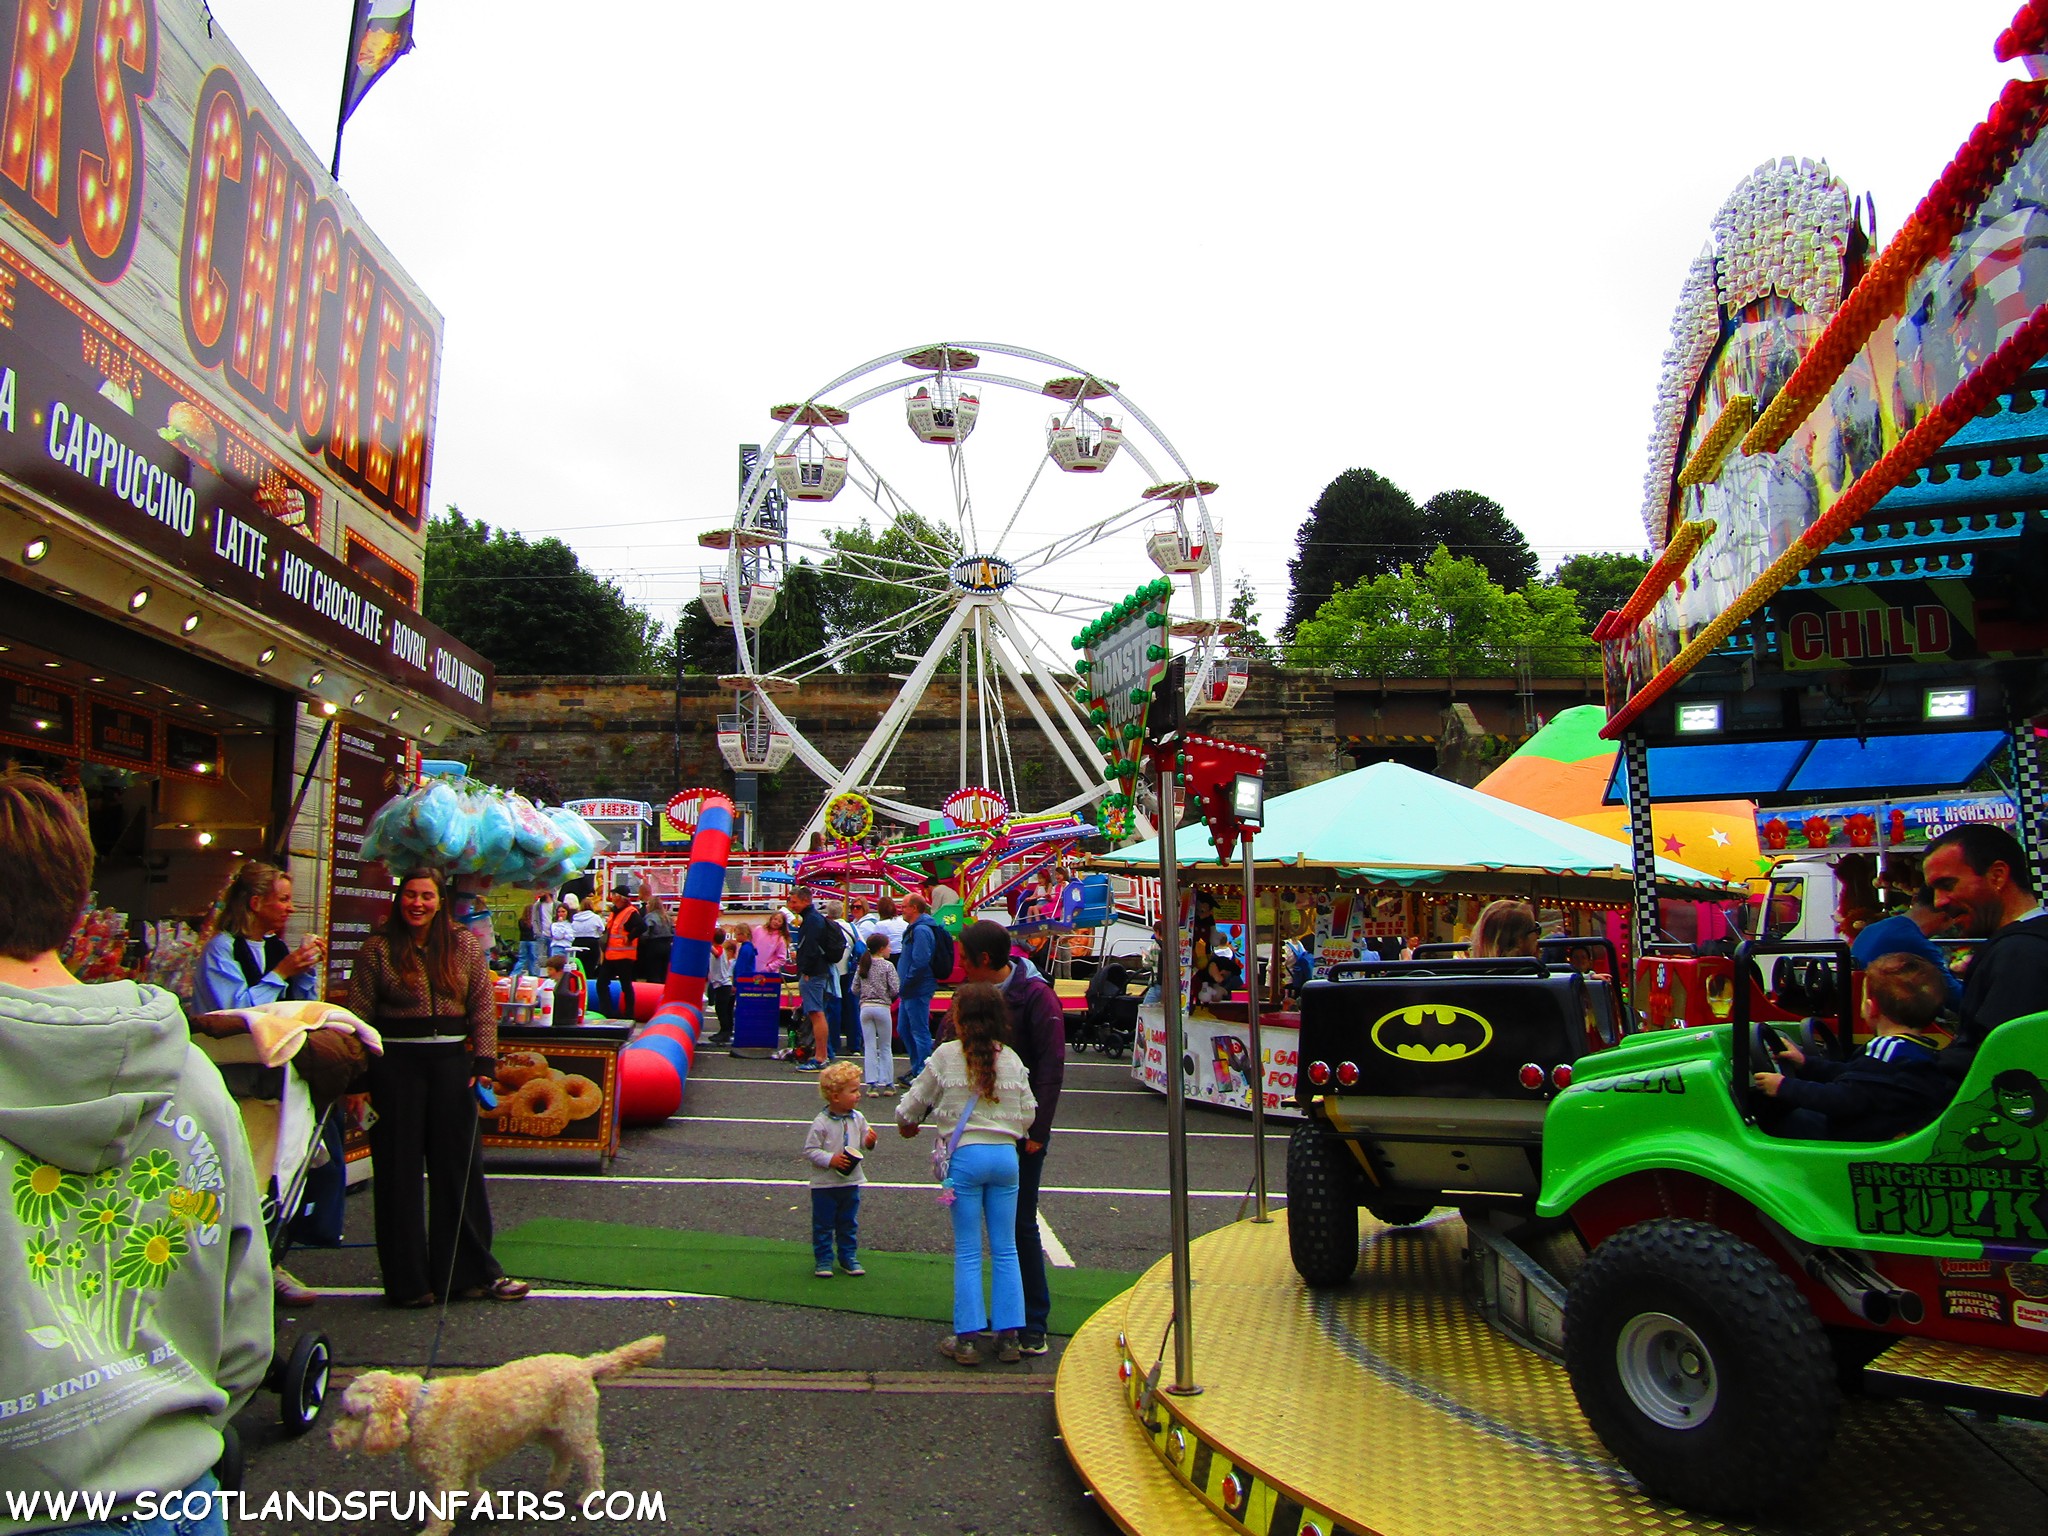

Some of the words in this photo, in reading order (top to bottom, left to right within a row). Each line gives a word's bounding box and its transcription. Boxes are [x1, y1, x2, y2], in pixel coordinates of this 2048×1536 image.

[188, 90, 431, 518] CHICKEN
[82, 327, 143, 399] WRAPS
[225, 437, 257, 481] FOOT
[49, 402, 196, 538] CAPPUCCINO
[215, 508, 268, 580] LATTE
[282, 550, 314, 604] HOT
[313, 569, 384, 646] CHOCOLATE
[392, 619, 427, 672] BOVRIL
[435, 647, 458, 688] COLD
[459, 665, 485, 704] WATER
[954, 563, 985, 585] MOVIE
[988, 563, 1013, 585] STAR
[1789, 604, 1952, 662] CHILD
[1091, 627, 1164, 699] MONSTER
[568, 802, 597, 817] PAY
[601, 802, 638, 817] HERE
[947, 796, 976, 823] MOVIE
[980, 796, 1005, 823] STAR
[1915, 807, 1939, 823] THE
[1322, 949, 1352, 959] OVER
[1151, 1029, 1167, 1045] GAM
[1148, 1047, 1162, 1066] FOR
[1274, 1049, 1298, 1066] GA
[498, 1115, 563, 1134] DONUTS
[1862, 1163, 2040, 1190] INCREDIBLE
[1852, 1185, 2048, 1239] HULK
[1945, 1290, 2000, 1304] MONSTER
[1950, 1297, 1998, 1311] TRUCK
[1949, 1305, 2002, 1320] MATER
[41, 1370, 101, 1407] KIND
[101, 1362, 122, 1380] TO
[119, 1353, 148, 1373] THE
